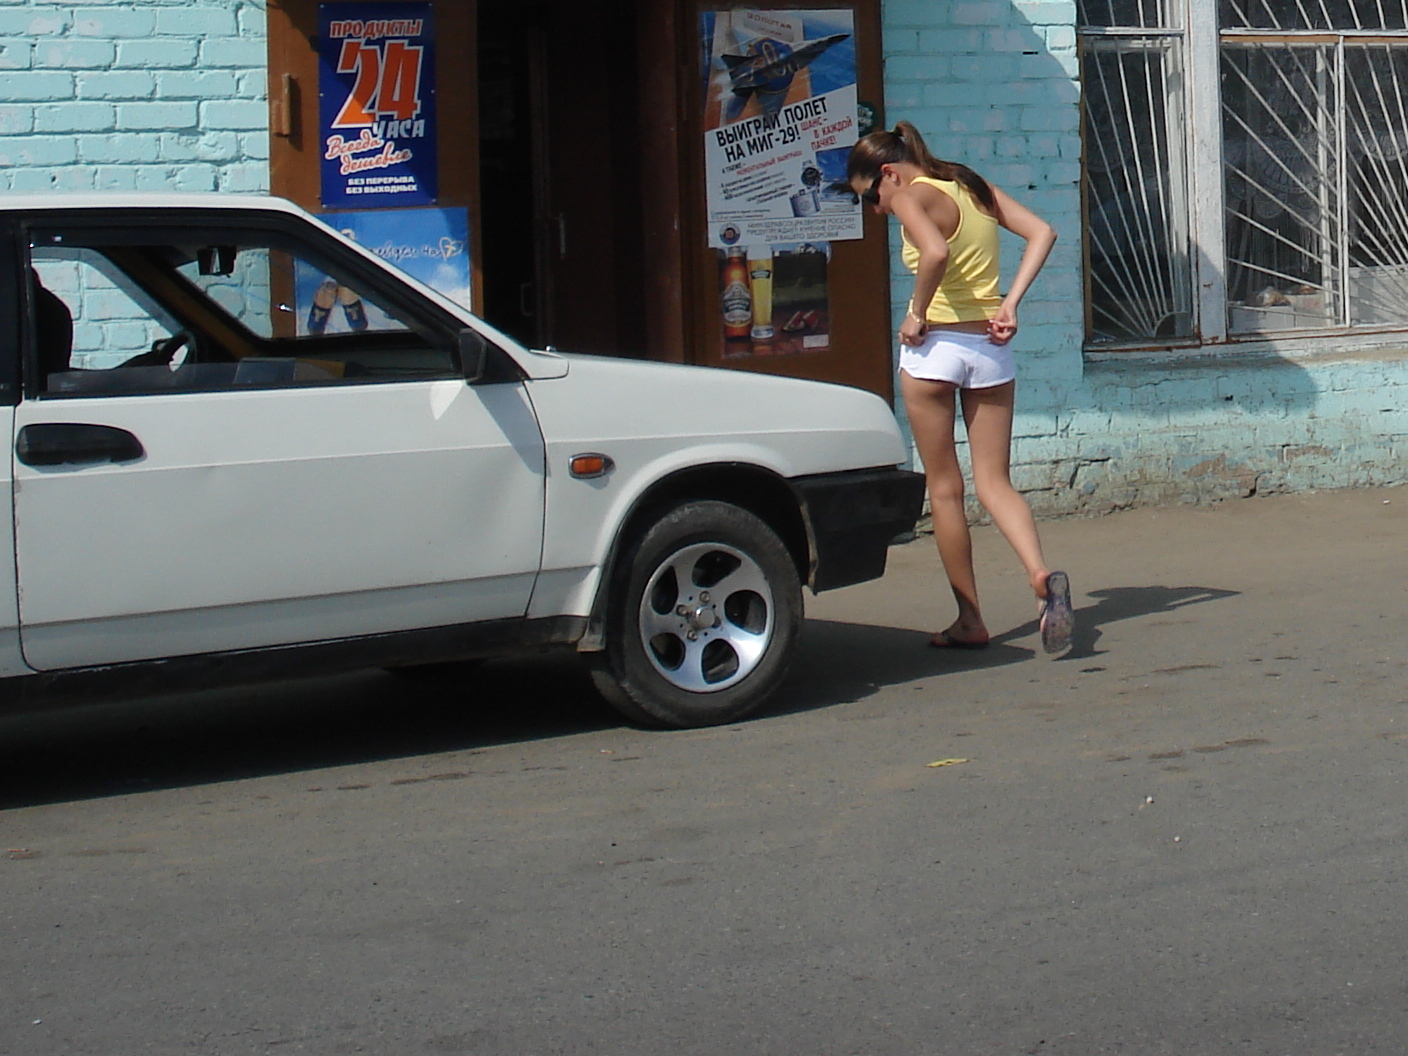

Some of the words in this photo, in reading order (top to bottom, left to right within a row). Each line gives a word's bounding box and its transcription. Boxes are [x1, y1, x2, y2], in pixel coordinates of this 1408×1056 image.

[329, 19, 423, 40] ПРОДУКТЫ
[331, 38, 424, 129] 24
[372, 119, 425, 139] ЧАСА
[716, 110, 780, 147] ВЫИГРАЙ
[784, 97, 827, 125] ПОЛЕТ
[822, 116, 853, 136] КАЖДОЙ
[325, 129, 385, 160] Всегда
[725, 146, 746, 163] НА
[748, 125, 801, 156] МИГ-29!
[340, 141, 413, 175] дешевле
[348, 177, 365, 185] БЕЗ
[366, 176, 415, 184] ПЕРЕРЫВА
[363, 184, 418, 194] ВЫХОДНЫХ
